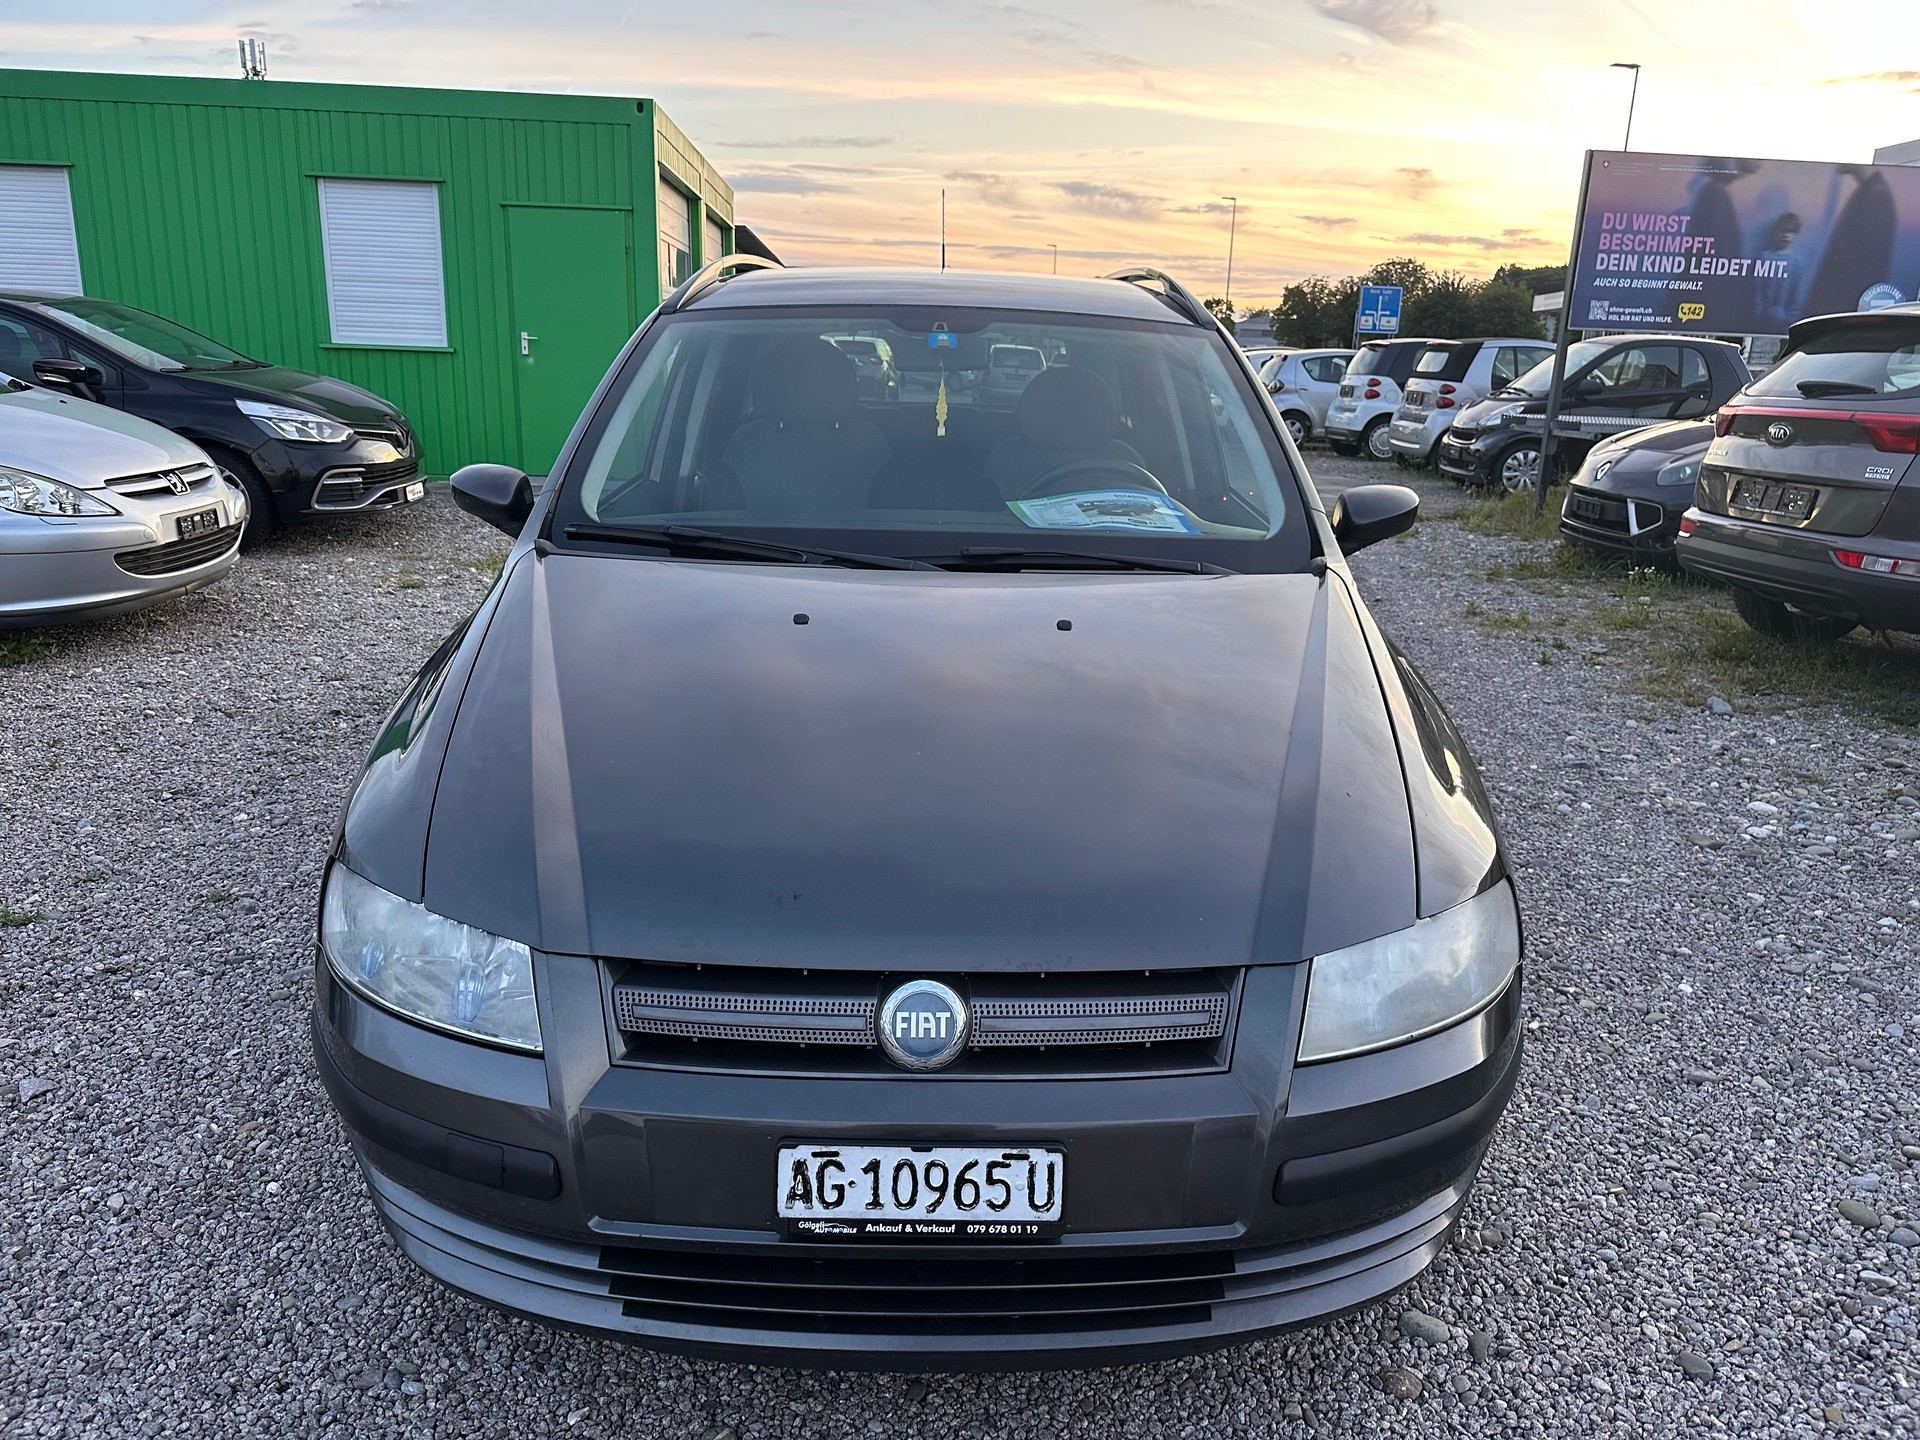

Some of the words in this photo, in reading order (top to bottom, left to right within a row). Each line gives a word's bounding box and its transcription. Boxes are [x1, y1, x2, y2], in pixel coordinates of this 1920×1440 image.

[1601, 212, 1628, 230] DU
[1632, 213, 1691, 233] WIRST
[1598, 232, 1715, 255] BESCHIMPFT.
[1595, 252, 1639, 272] DEIN
[1641, 254, 1686, 274] KIND
[1689, 256, 1752, 277] LEIDET
[1753, 259, 1788, 279] MIT.
[1593, 277, 1618, 287] AUCH
[1618, 278, 1631, 288] SO
[1631, 279, 1669, 289] BEGINNT
[1668, 280, 1703, 291] GEWALT.
[1609, 306, 1653, 314] ohne-gewalt.ch
[1687, 306, 1703, 316] 142
[1620, 314, 1631, 322] DIR
[1655, 315, 1673, 323] HILFE.
[895, 1011, 951, 1039] FIAT
[865, 1223, 903, 1233] Ankauf
[904, 1223, 913, 1233] &
[915, 1223, 956, 1233] Verkauf
[966, 1224, 986, 1234] 079
[988, 1224, 1008, 1234] 678
[1009, 1224, 1022, 1234] 01
[1025, 1224, 1039, 1234] 19
